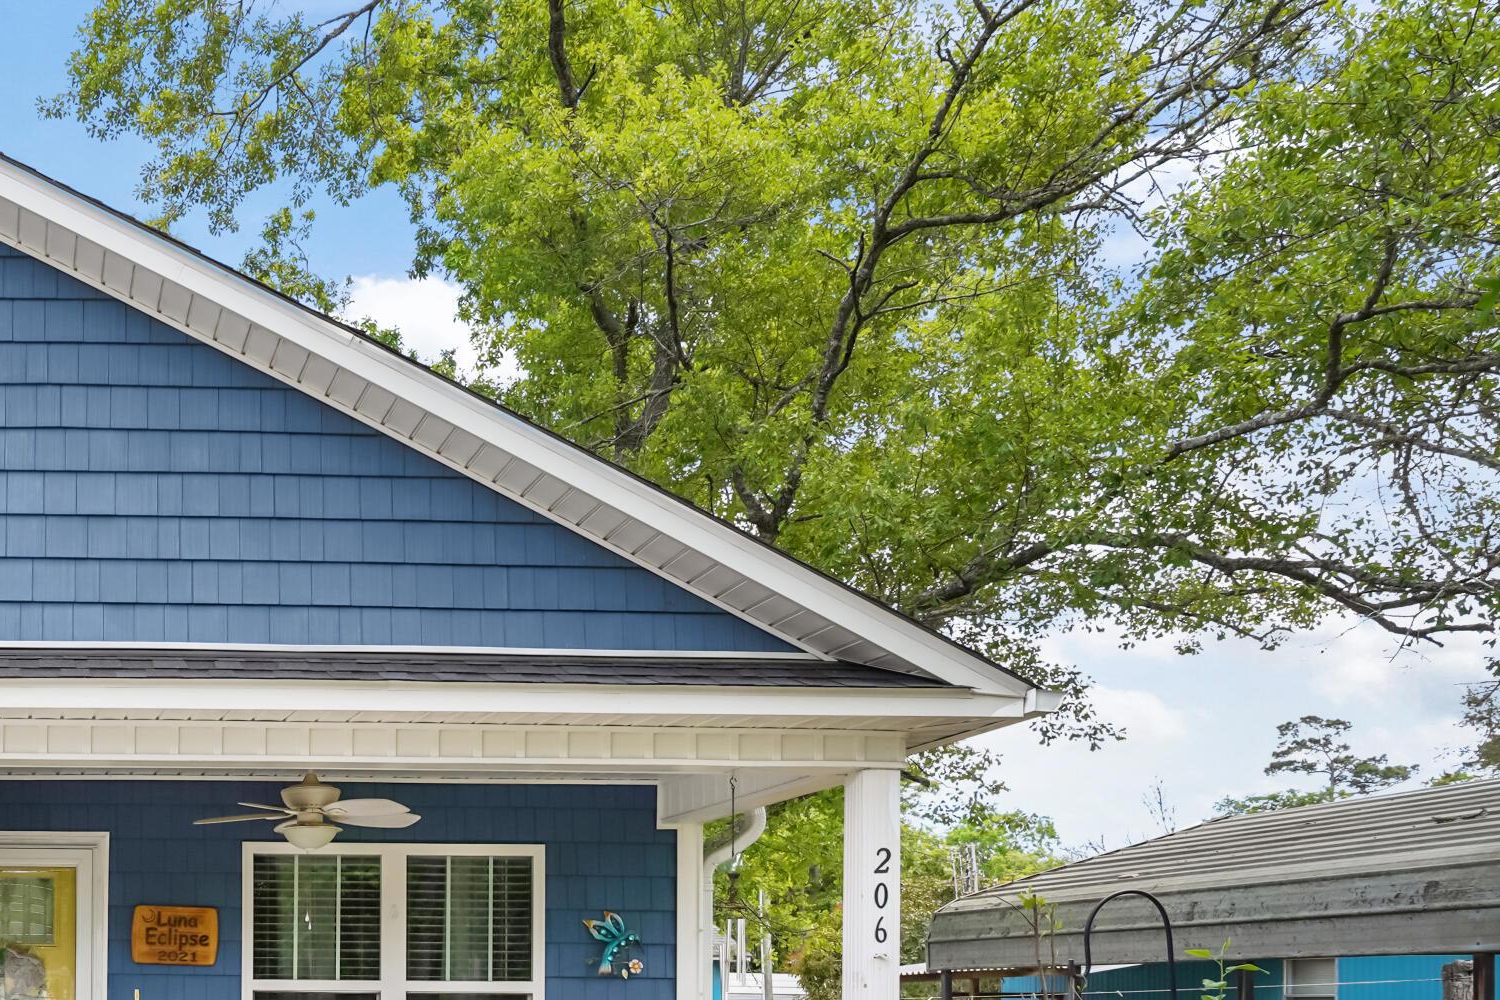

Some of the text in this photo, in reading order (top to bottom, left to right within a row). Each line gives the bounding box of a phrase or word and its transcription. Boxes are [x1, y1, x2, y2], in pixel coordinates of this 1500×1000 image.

[873, 847, 892, 944] 206
[156, 911, 198, 928] Luna
[145, 927, 209, 950] Eclipse
[158, 951, 197, 962] 2021
